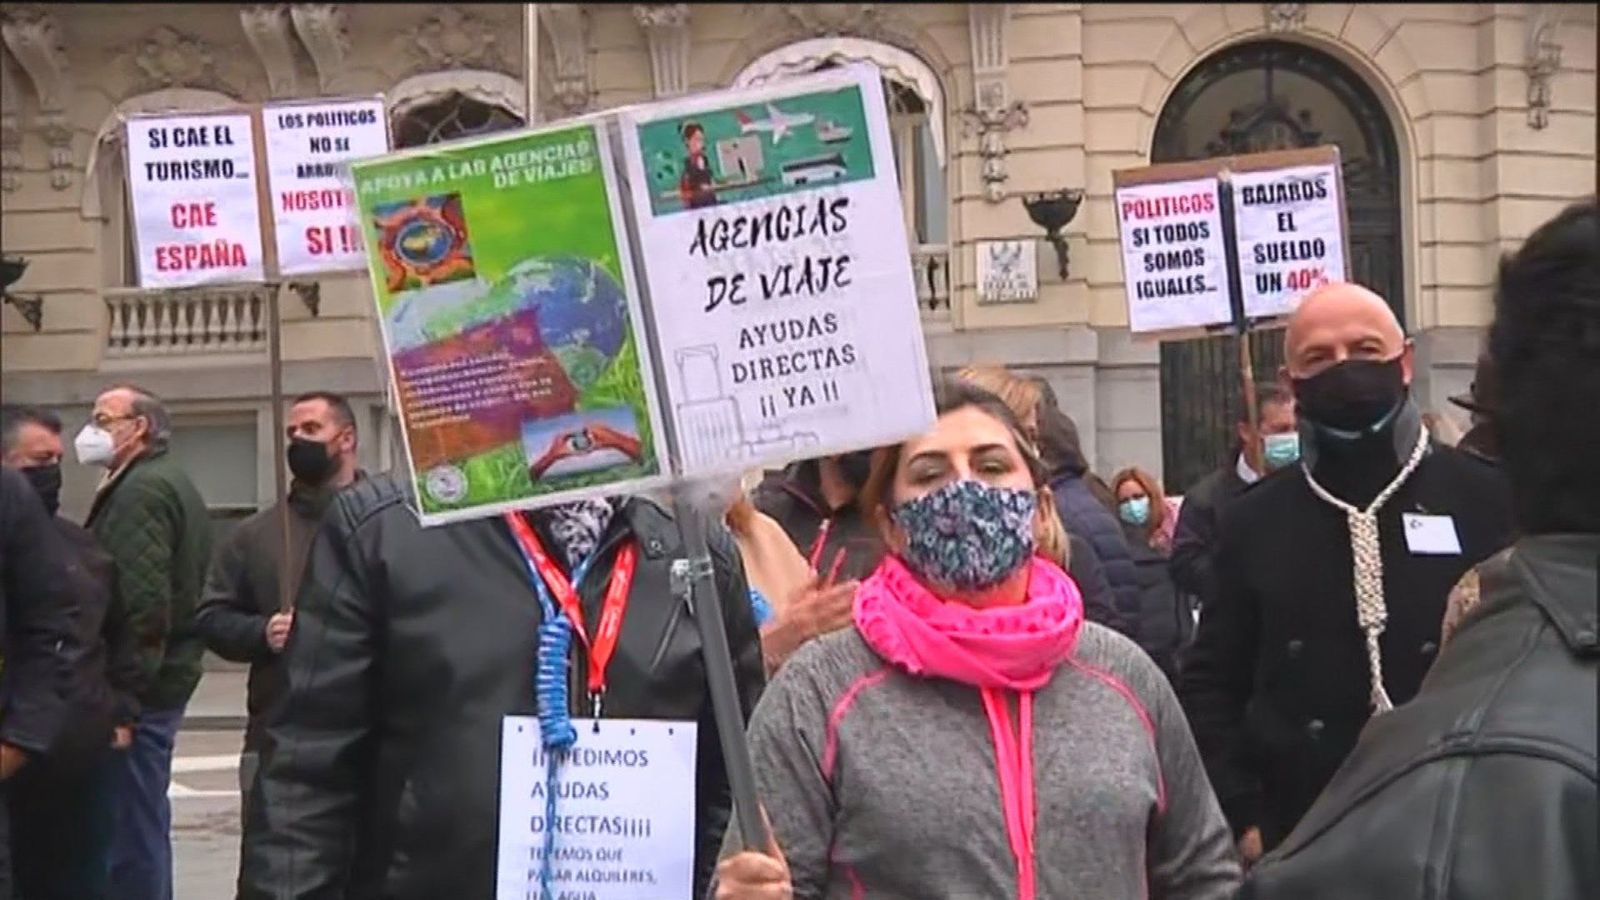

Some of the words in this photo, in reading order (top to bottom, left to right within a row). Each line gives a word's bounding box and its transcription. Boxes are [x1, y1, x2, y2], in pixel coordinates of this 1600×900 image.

[278, 114, 304, 130] LOS
[307, 108, 377, 128] POLITICOS
[148, 128, 168, 149] SI
[173, 127, 210, 148] CAE
[215, 125, 235, 145] EL
[309, 136, 331, 153] NO
[335, 137, 350, 152] SE
[361, 170, 428, 194] APOYA
[432, 167, 446, 183] A
[450, 159, 487, 179] LAS
[491, 140, 590, 172] AGENCIAS
[494, 172, 519, 189] DE
[524, 159, 595, 184] VIAJES
[1242, 179, 1327, 206] BAJAROS
[171, 202, 217, 230] CAE
[1122, 192, 1215, 221] POLITICOS
[689, 197, 849, 257] AGENCIAS
[1133, 228, 1149, 247] SI
[1153, 221, 1210, 245] TODOS
[1277, 212, 1297, 233] EL
[306, 226, 332, 255] SI
[1253, 238, 1326, 265] SUELDO
[156, 239, 247, 272] ESPAÑA
[1143, 248, 1205, 273] SOMOS
[704, 273, 747, 313] DE
[759, 255, 852, 301] VIAJE
[1256, 272, 1282, 294] UN
[1286, 266, 1329, 292] 40%
[739, 312, 838, 350] AYUDAS
[731, 344, 856, 384] DIRECTAS
[782, 384, 815, 408] YA
[531, 781, 610, 800] AUDAS
[530, 846, 592, 861] TEEMOS
[596, 846, 623, 861] QUE
[528, 869, 572, 882] PAAR
